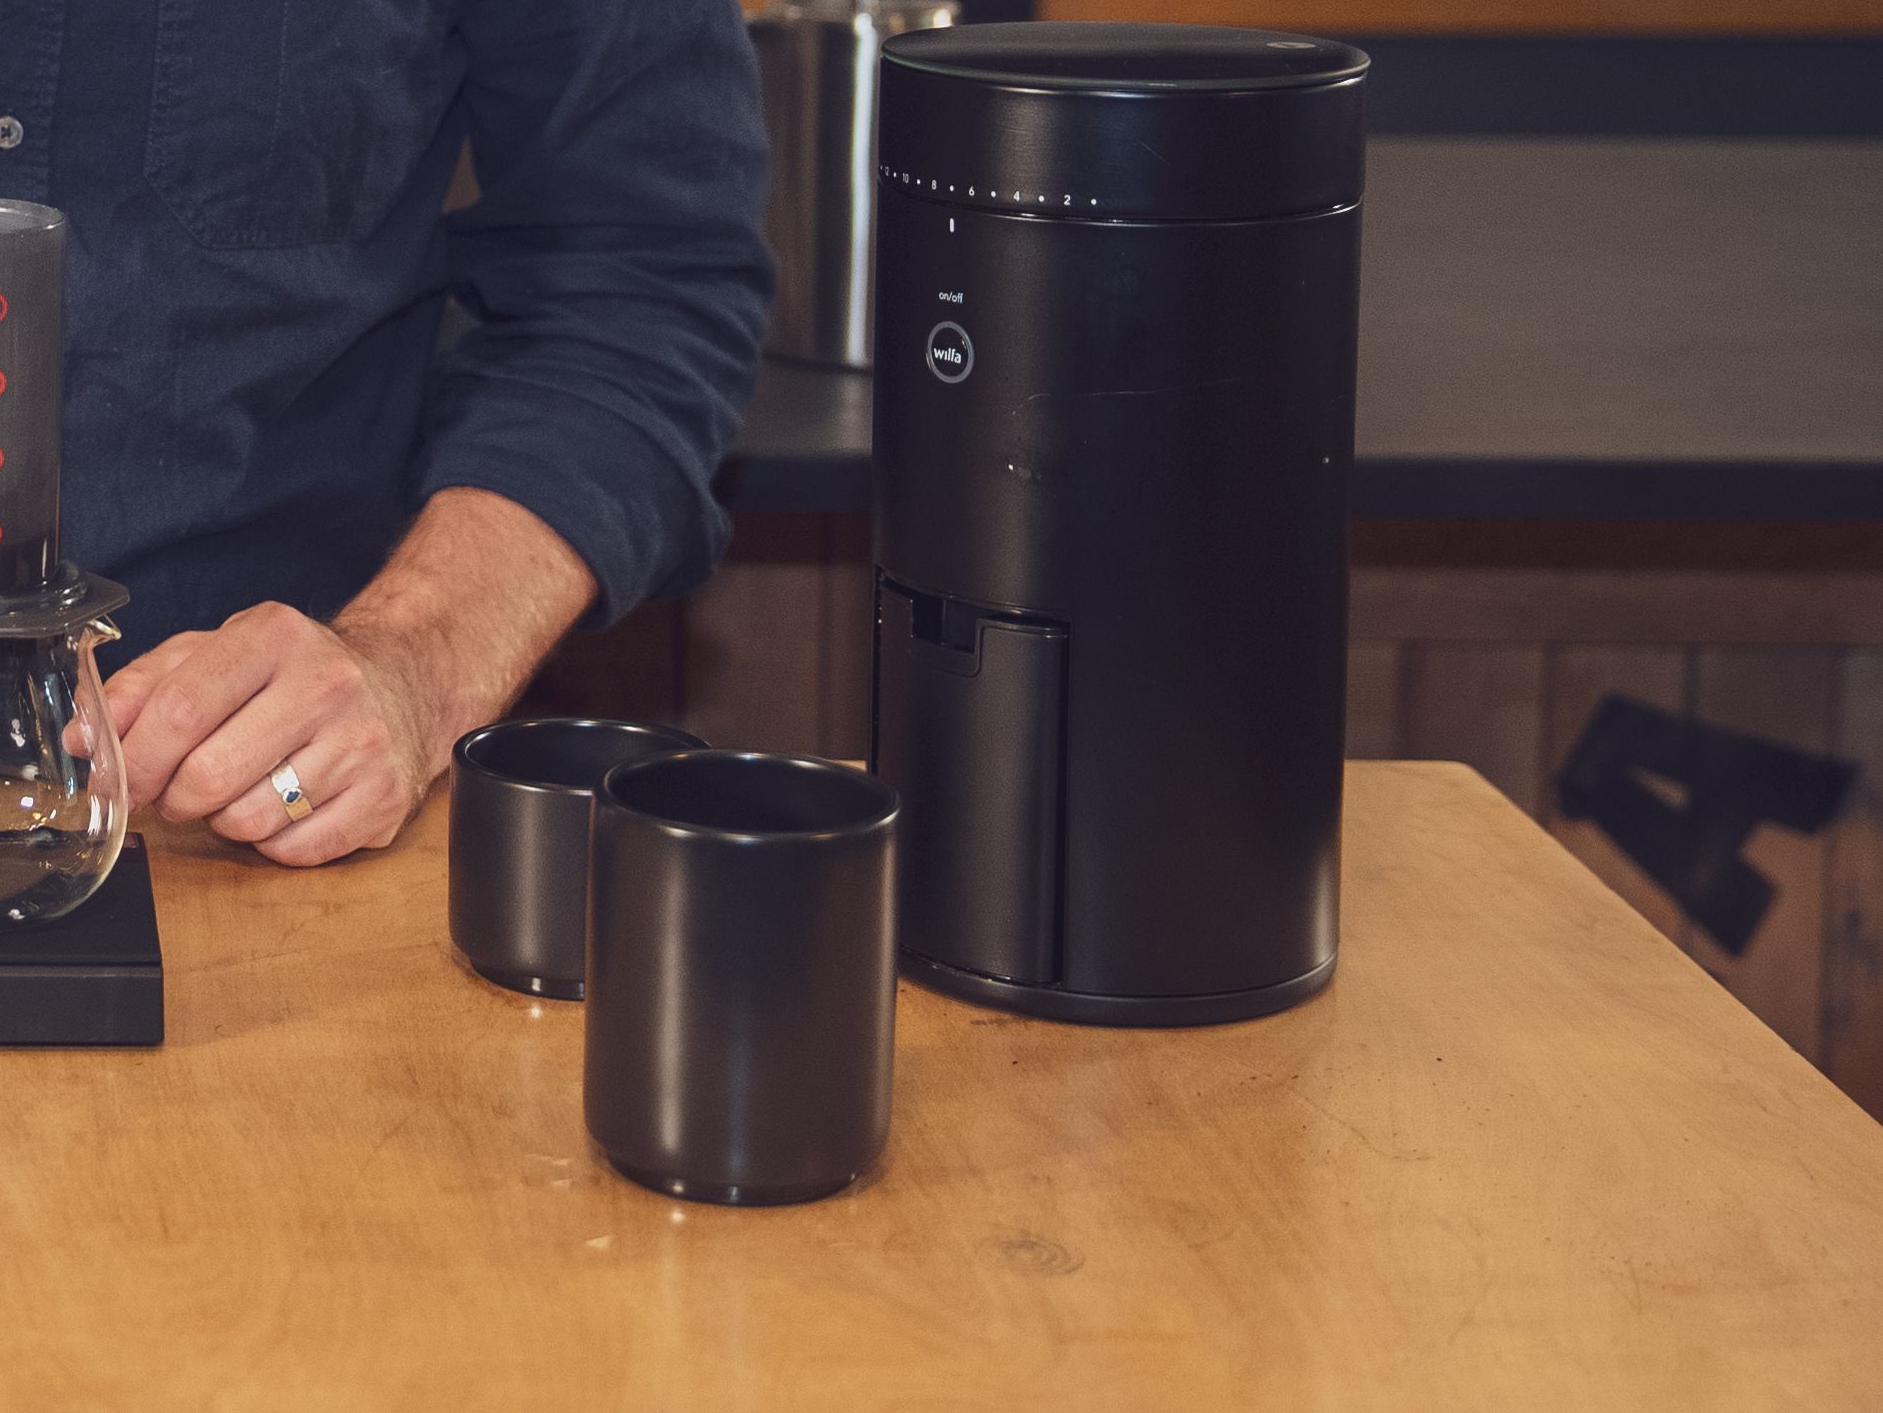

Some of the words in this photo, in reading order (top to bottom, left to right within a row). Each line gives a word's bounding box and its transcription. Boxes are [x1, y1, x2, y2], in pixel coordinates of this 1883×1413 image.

[931, 179, 937, 190] 8
[968, 186, 975, 196] 6
[1013, 191, 1020, 201] 4
[1064, 195, 1071, 206] 2
[938, 292, 963, 304] on/off
[933, 347, 962, 364] wilfa
